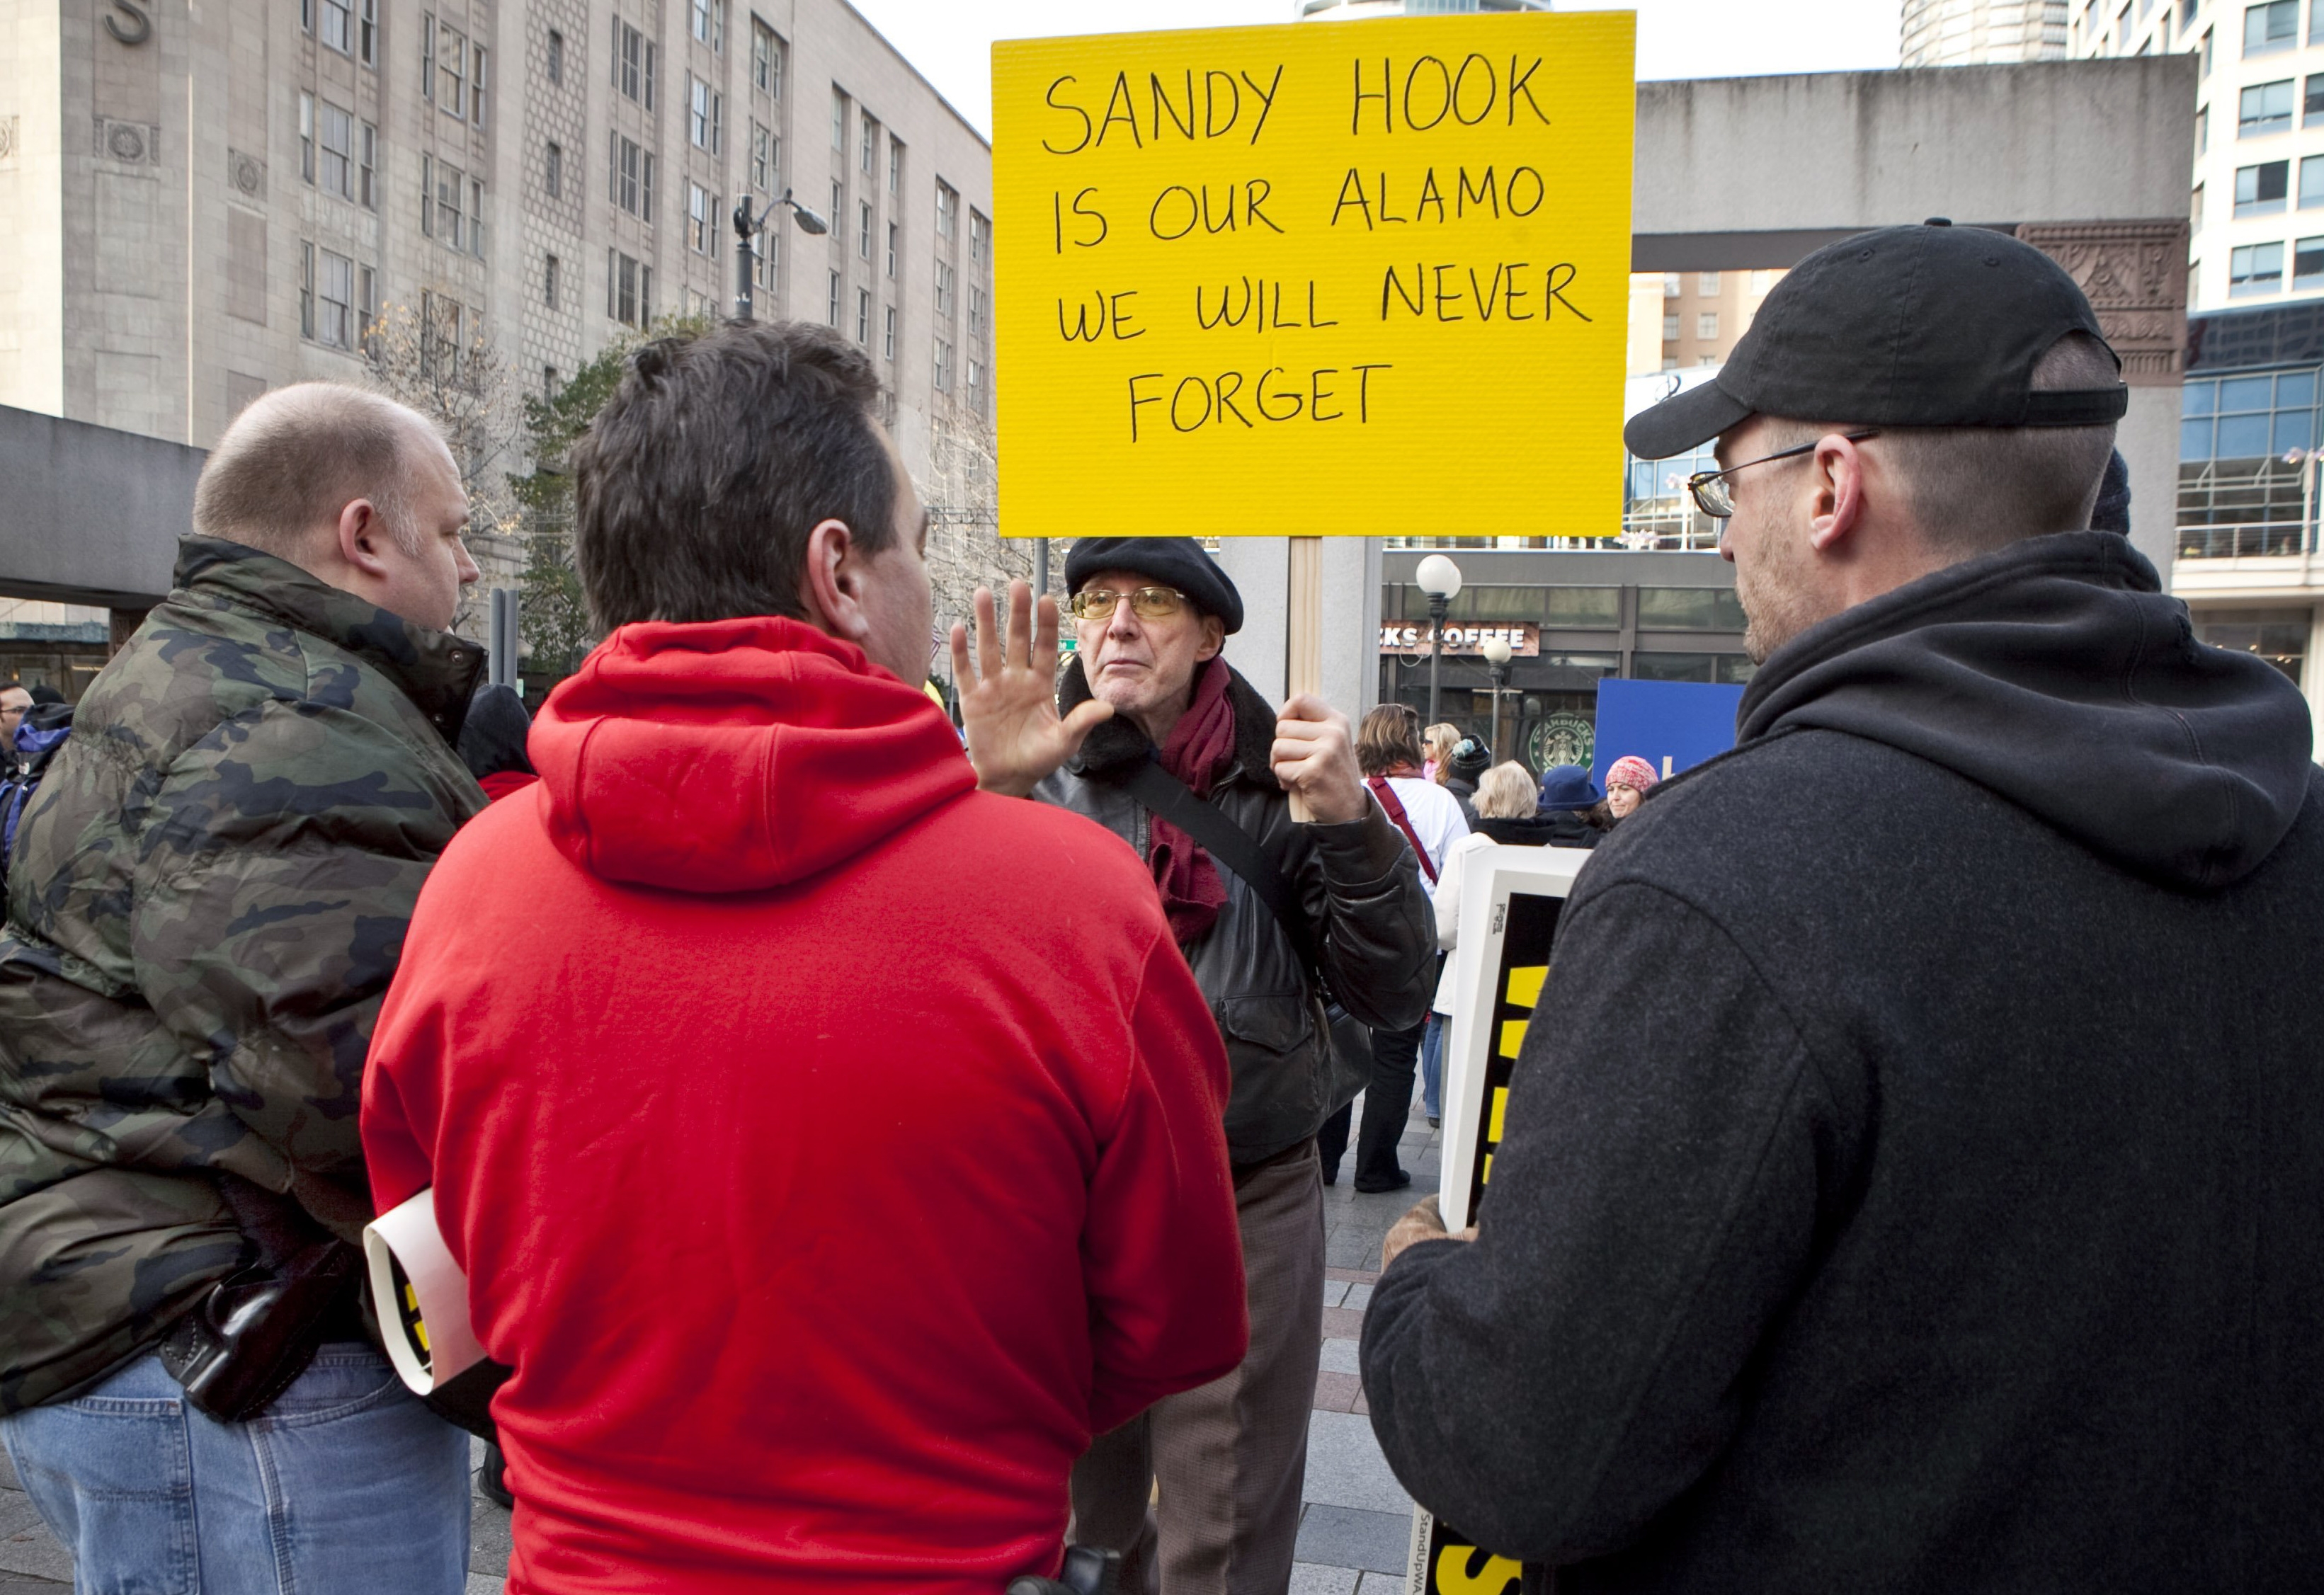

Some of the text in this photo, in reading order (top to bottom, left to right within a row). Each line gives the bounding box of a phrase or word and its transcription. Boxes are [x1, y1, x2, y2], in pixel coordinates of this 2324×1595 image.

[1042, 53, 1551, 154] SANDY HOOK
[1055, 166, 1544, 254] IS OUR ALAMO
[1059, 263, 1593, 342] WE WILL NEVER
[1129, 365, 1393, 443] FORGET
[1380, 627, 1418, 646] KS
[1533, 719, 1594, 745] SARBUCKS
